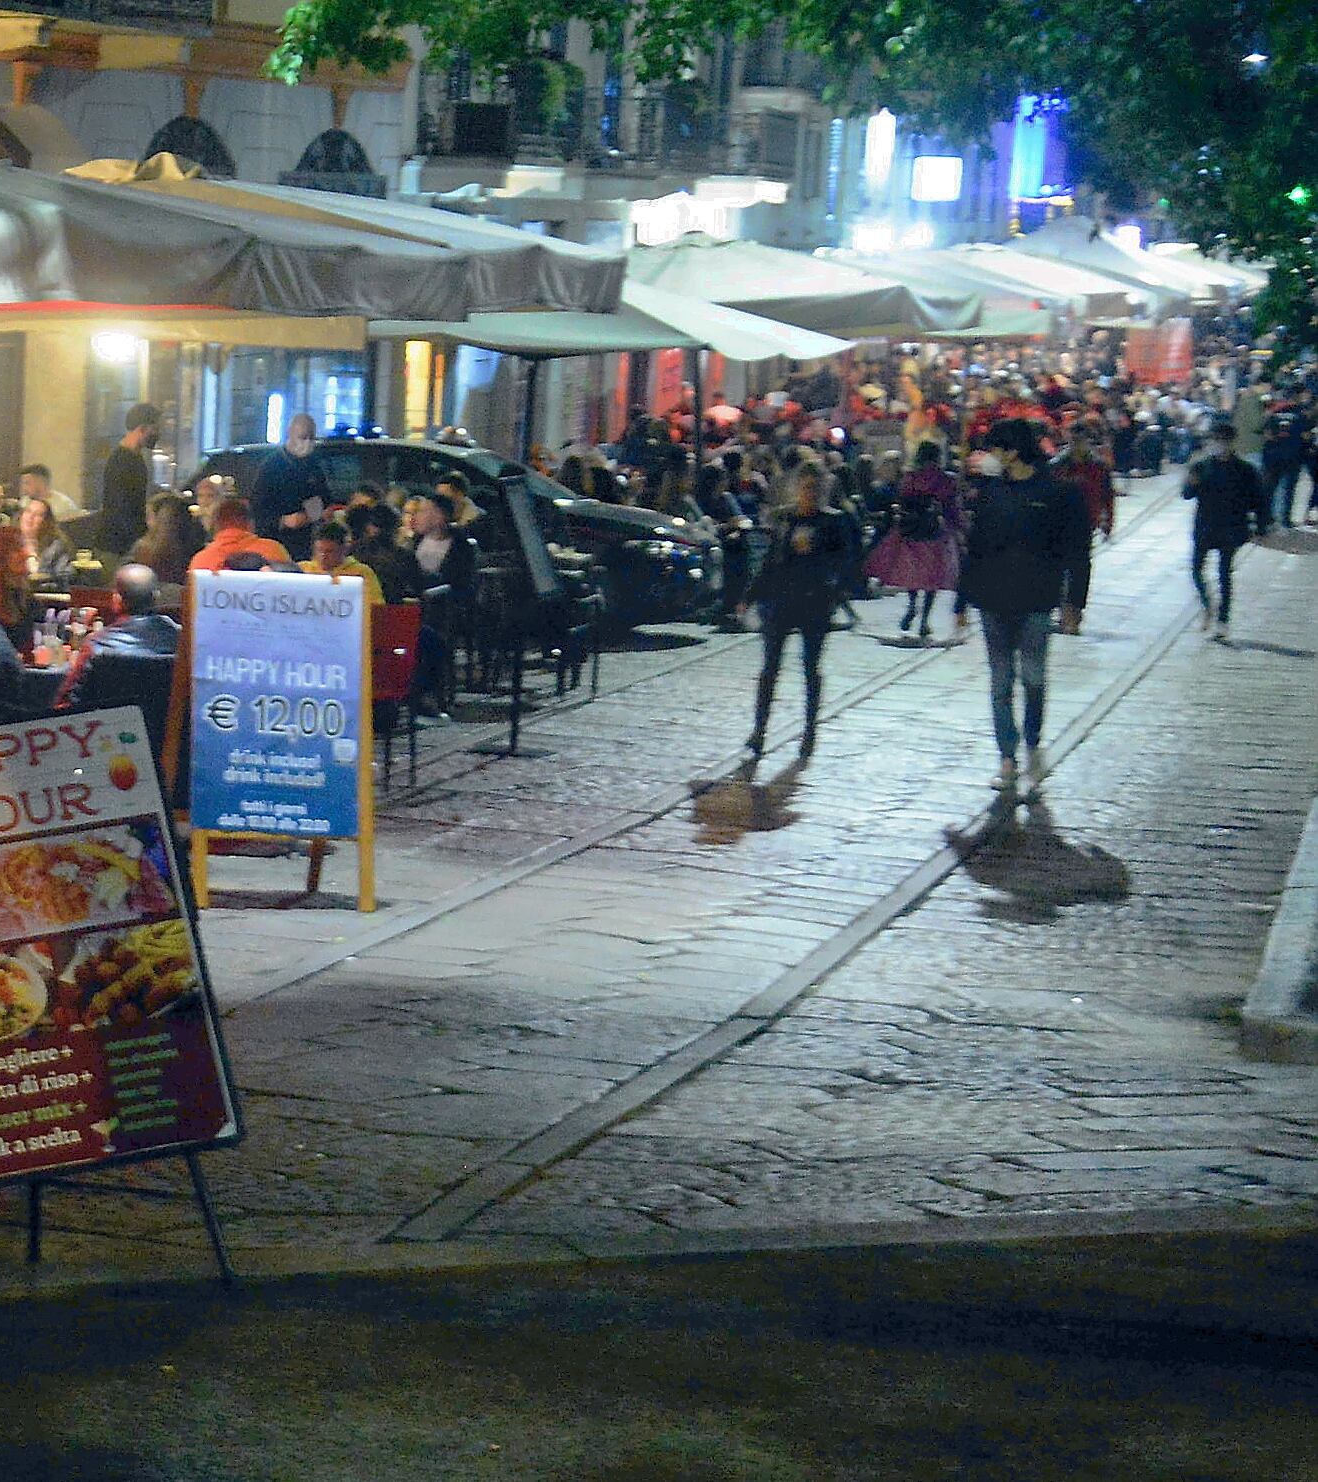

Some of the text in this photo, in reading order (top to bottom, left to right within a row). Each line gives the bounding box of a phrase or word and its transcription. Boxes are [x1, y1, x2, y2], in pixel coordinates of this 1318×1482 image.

[202, 588, 353, 618] LONG ISLAND
[207, 656, 347, 690] HAPPY HOUR
[205, 696, 239, 731] €
[19, 1074, 40, 1094] di
[41, 1071, 79, 1091] riso
